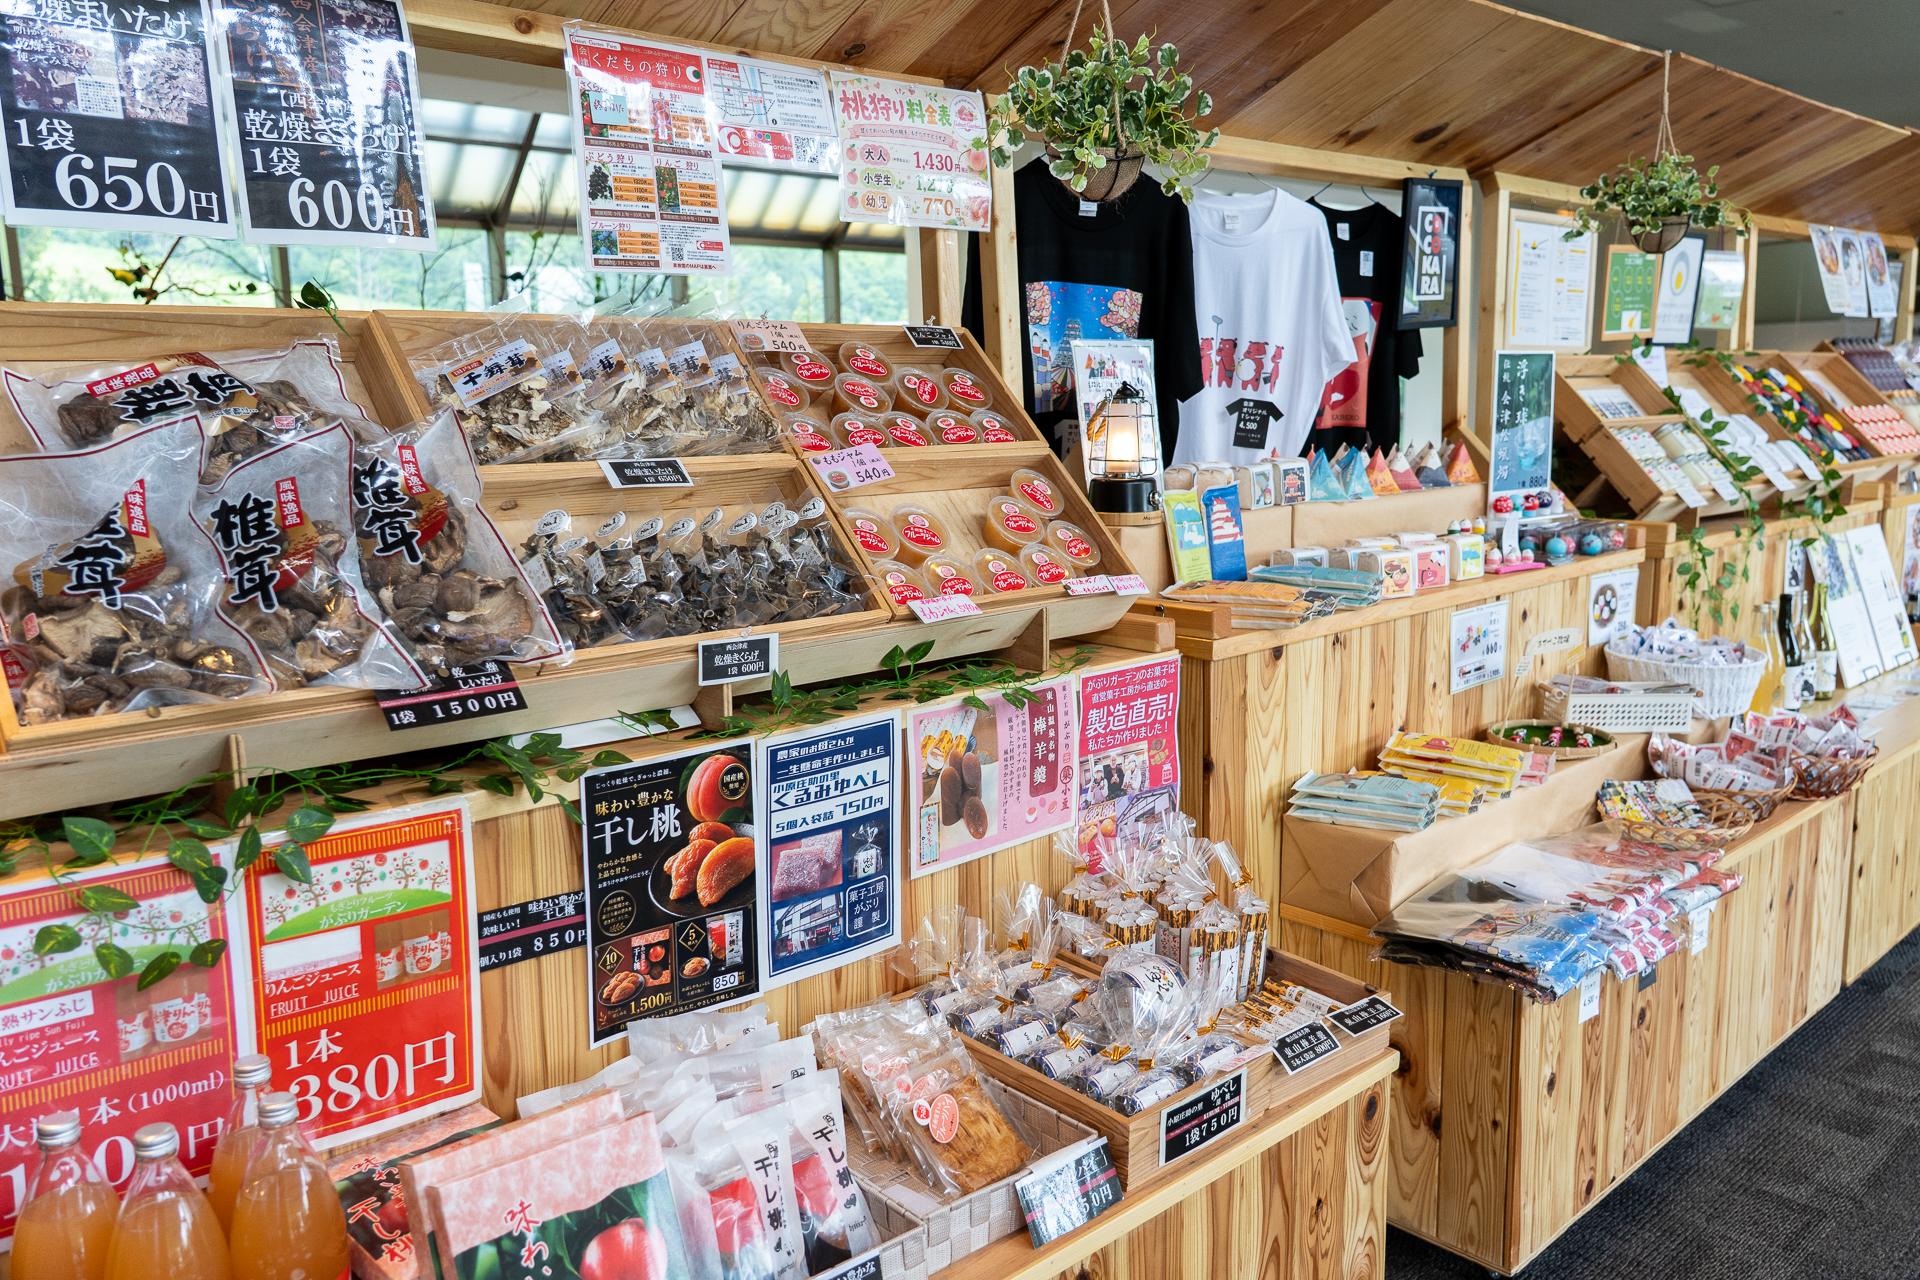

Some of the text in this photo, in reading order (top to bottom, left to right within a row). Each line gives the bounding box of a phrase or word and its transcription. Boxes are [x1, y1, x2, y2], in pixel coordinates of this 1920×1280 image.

[579, 46, 589, 66] 会津
[592, 53, 682, 79] くだもの狩り
[839, 89, 952, 127] 桃狩り料金表
[14, 117, 76, 152] 1袋
[250, 146, 302, 176] 1袋
[586, 151, 634, 164] ぶどう狩り
[656, 158, 699, 170] りんご狩り
[864, 148, 961, 173] 大人 1,430円
[55, 153, 219, 223] 650円
[863, 172, 892, 186] 小学生
[288, 177, 415, 237] 600円
[865, 194, 961, 217] 幼児 770円
[591, 221, 631, 232] プルーン狩り
[1424, 213, 1442, 234] CO
[1423, 235, 1442, 255] CO
[1422, 255, 1441, 275] KA
[1420, 275, 1440, 295] RA
[737, 320, 788, 330] りんごジャム
[772, 340, 807, 352] 540円
[93, 365, 158, 396] 風味逸品
[1241, 413, 1260, 421] Tシャツ
[1242, 407, 1267, 415] オリジナル
[1331, 414, 1360, 422] KABEKO
[823, 450, 863, 466] ももジャム
[852, 459, 867, 468] 1個
[402, 448, 427, 493] 風味逸品
[856, 467, 891, 483] 540円
[125, 482, 147, 534] 風味逸品
[278, 480, 302, 527] 風味逸品
[353, 456, 424, 565] 椎茸
[905, 530, 941, 544] フルーツジャム
[211, 493, 282, 614] 椎茸
[714, 650, 760, 666] 乾燥きくらげ
[726, 642, 749, 651] 西会津産
[728, 660, 765, 675] 1袋 600円
[1087, 662, 1176, 691] がぶりガーデンのお菓子は
[458, 674, 504, 690] しいたけ
[391, 691, 518, 725] 1袋 1500円
[1045, 690, 1056, 763] 東山温泉名物
[1063, 720, 1071, 751] がぶり
[777, 736, 855, 761] 農家のお母さんが
[777, 745, 885, 775] 一生懸命手作りしました
[1033, 716, 1047, 786] 棒羊羹
[723, 772, 745, 783] 国産桃
[773, 770, 840, 793] 小原庄助の里
[773, 769, 886, 808] くるみゆべし
[595, 788, 674, 816] 味わい豊かな
[1060, 784, 1071, 812] 小豆
[776, 795, 884, 833] 5個入袋詰 750円
[593, 803, 683, 855] 干し桃
[597, 853, 643, 870] やわらかな食感と
[597, 867, 630, 880] 上品な甘さ。
[330, 892, 394, 913] もぎとりフルーツ
[849, 880, 885, 903] 菓子工房
[320, 902, 408, 929] がぶりガーデン
[483, 907, 521, 922] 国産もも使用
[543, 904, 576, 921] 干し桃
[854, 897, 880, 915] がぶり
[689, 928, 696, 941] 5
[479, 947, 523, 967] 個入り1袋
[605, 952, 617, 966] 10
[265, 963, 361, 997] りんごジュース
[270, 983, 360, 1018] FRUIT JUICE
[630, 992, 672, 1015] 1,500円
[1344, 1004, 1387, 1027] 東山棒羊羹
[19, 1018, 86, 1044] ripe Sun Fuji
[285, 1028, 344, 1071] 1本
[1284, 1030, 1328, 1057] 東山棒羊羹
[1314, 1039, 1335, 1055] 800円
[0, 1051, 98, 1091] RUIT JUICE
[289, 1030, 457, 1123] 380円
[1167, 1079, 1238, 1127] 小原庄助の里 ゆべし
[936, 1096, 953, 1141] フルーツパイ
[812, 1125, 855, 1190] 干し桃
